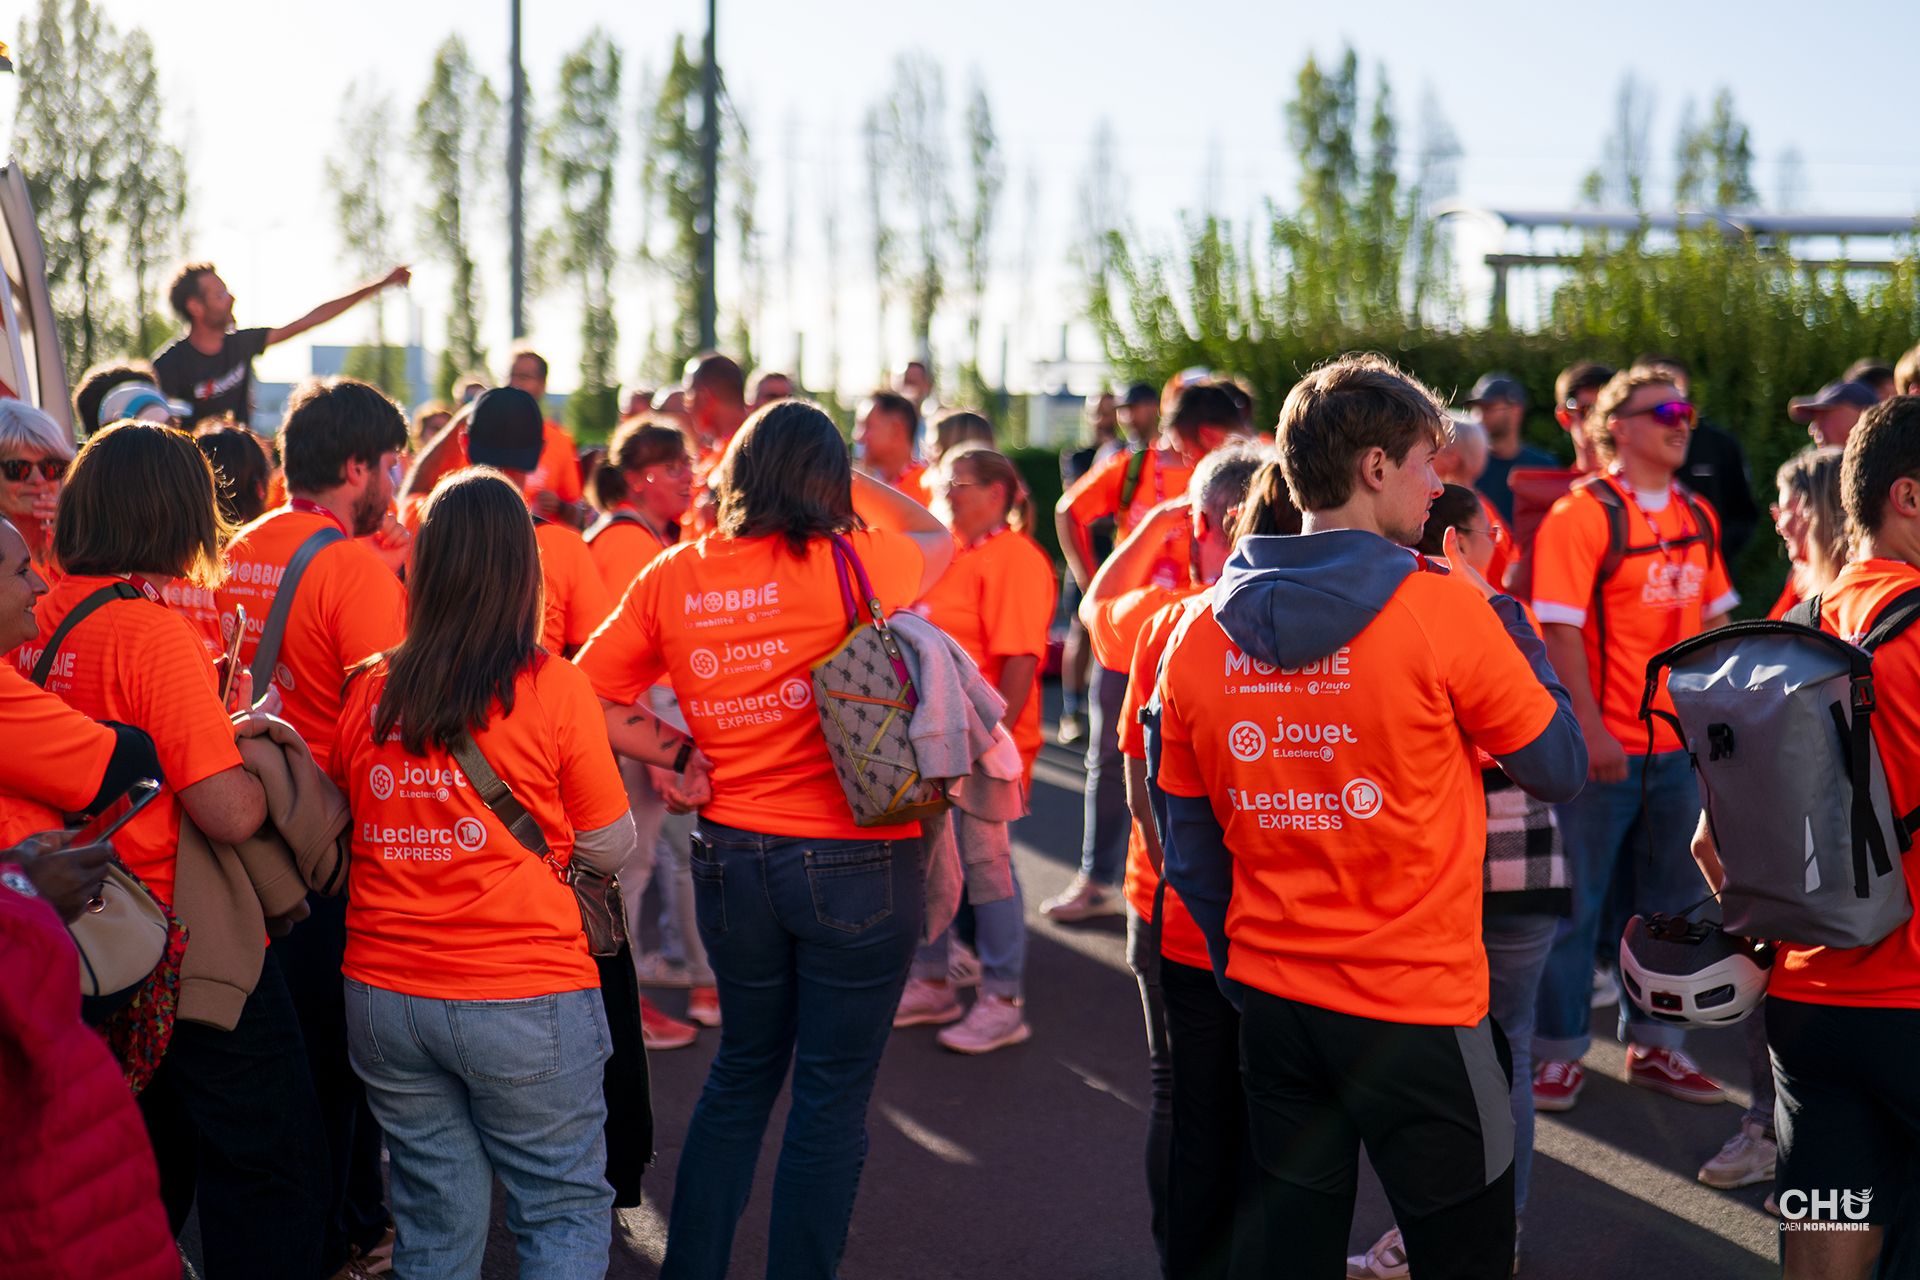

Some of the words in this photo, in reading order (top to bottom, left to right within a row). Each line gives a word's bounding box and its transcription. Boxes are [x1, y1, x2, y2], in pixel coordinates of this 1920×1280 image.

[684, 582, 779, 615] MOBBIE
[695, 616, 735, 628] mobilité
[722, 639, 789, 663] jouet
[19, 646, 76, 678] MOBIE
[1225, 685, 1236, 695] La
[1240, 682, 1291, 693] mobilité
[1294, 686, 1304, 695] by
[1320, 681, 1351, 690] l'auto
[690, 692, 779, 717] E.Leclerc
[716, 710, 783, 730] EXPRESS
[1272, 716, 1358, 744] jouet
[1273, 749, 1320, 759] E.Leclerc
[398, 761, 467, 788] jouet
[400, 790, 436, 799] E.Leclerc
[1258, 814, 1343, 831] EXPRESS
[363, 823, 452, 844] E.Leclerc
[383, 846, 452, 861] EXPRESS
